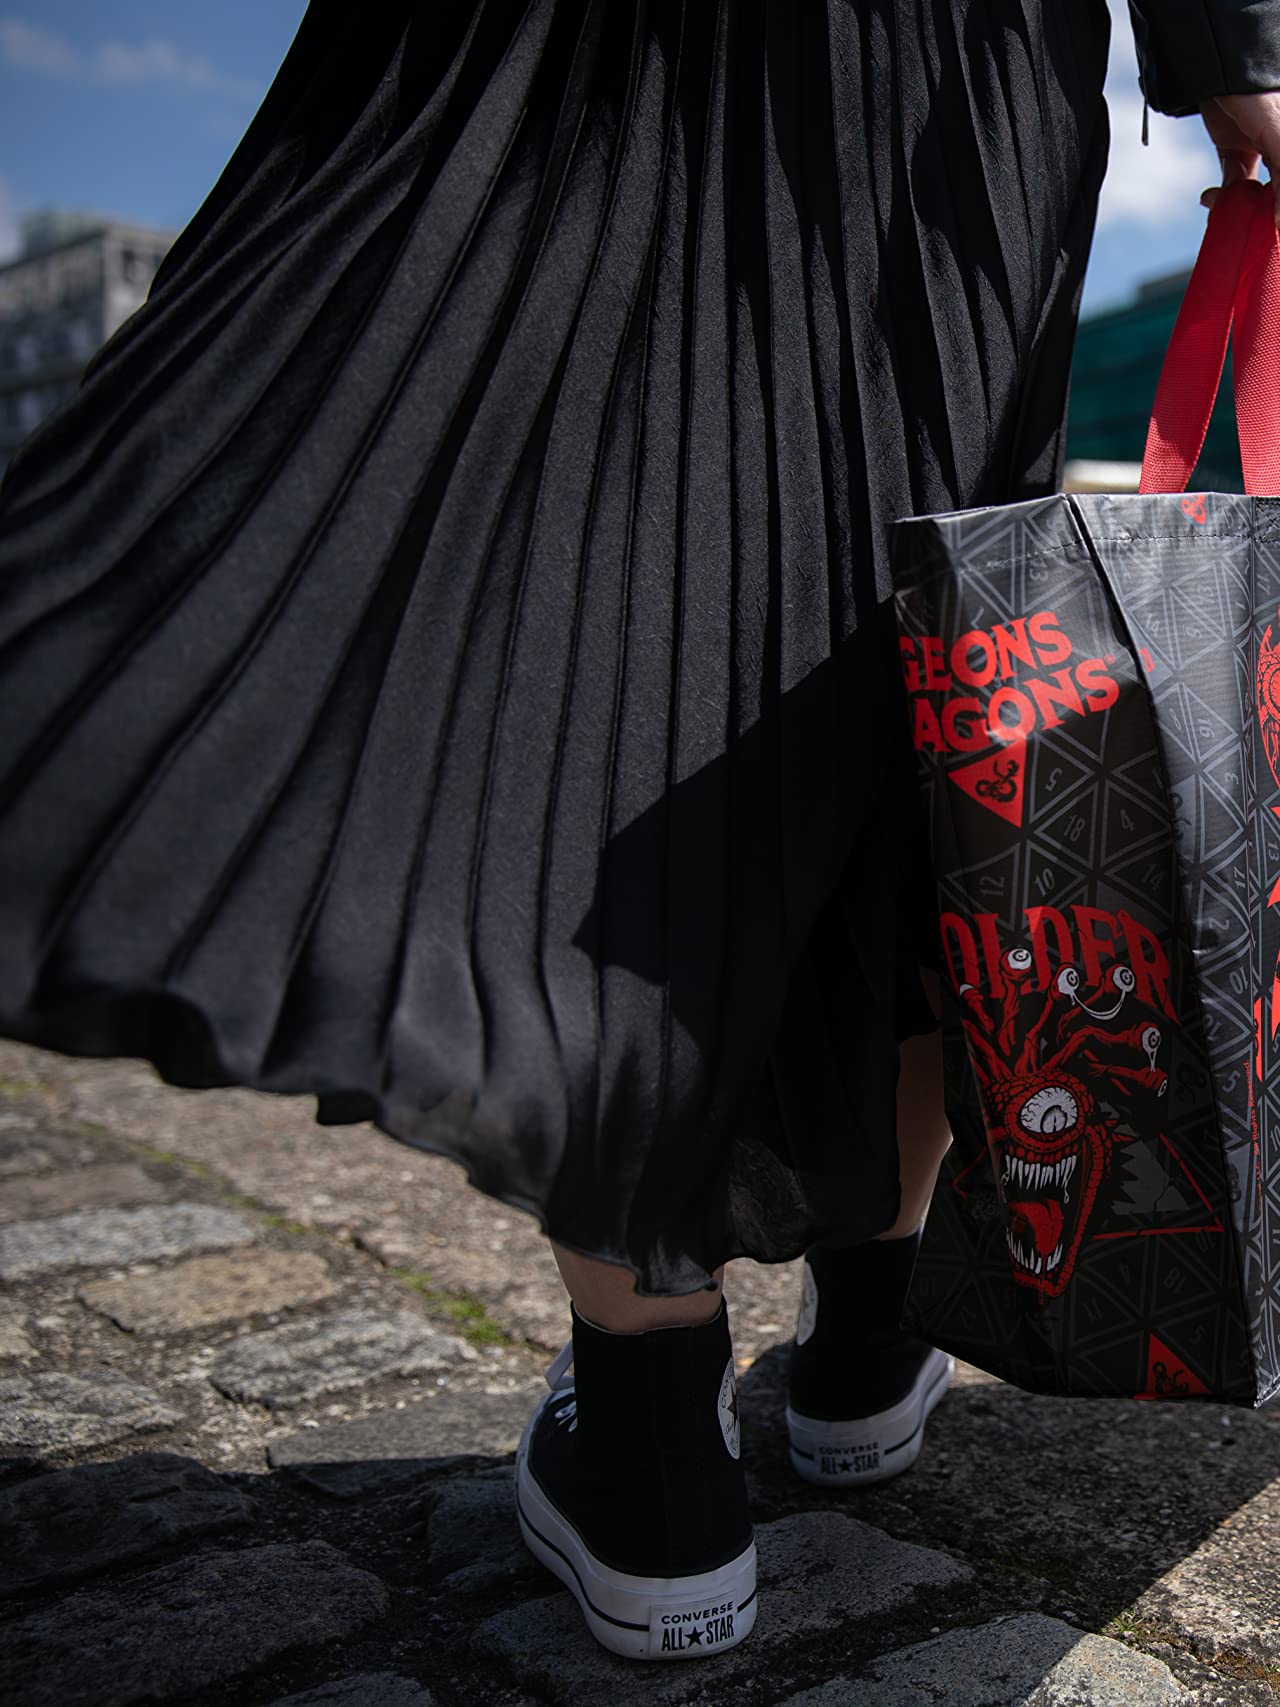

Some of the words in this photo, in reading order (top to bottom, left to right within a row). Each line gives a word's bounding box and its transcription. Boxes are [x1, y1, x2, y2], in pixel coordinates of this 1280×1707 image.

[900, 612, 1073, 691] GEONS
[914, 658, 1120, 752] AGONS
[1169, 708, 1181, 730] 8
[1045, 768, 1062, 791] 5
[1225, 772, 1239, 784] 3
[1063, 814, 1086, 842] 18
[1120, 809, 1134, 832] 4
[1268, 841, 1280, 861] 13
[979, 875, 1005, 897] 12
[1034, 868, 1055, 896] 10
[1233, 867, 1246, 888] 17
[1209, 918, 1230, 930] 2
[1229, 966, 1248, 995] 10
[1222, 1070, 1240, 1093] 5
[1251, 1110, 1259, 1141] Rights
[819, 1442, 878, 1455] CONVERSE
[821, 1456, 838, 1474] ALL
[854, 1452, 880, 1473] STAR
[661, 1601, 734, 1625] CONVERSE
[661, 1627, 686, 1651] ALL
[706, 1614, 734, 1644] STAR
